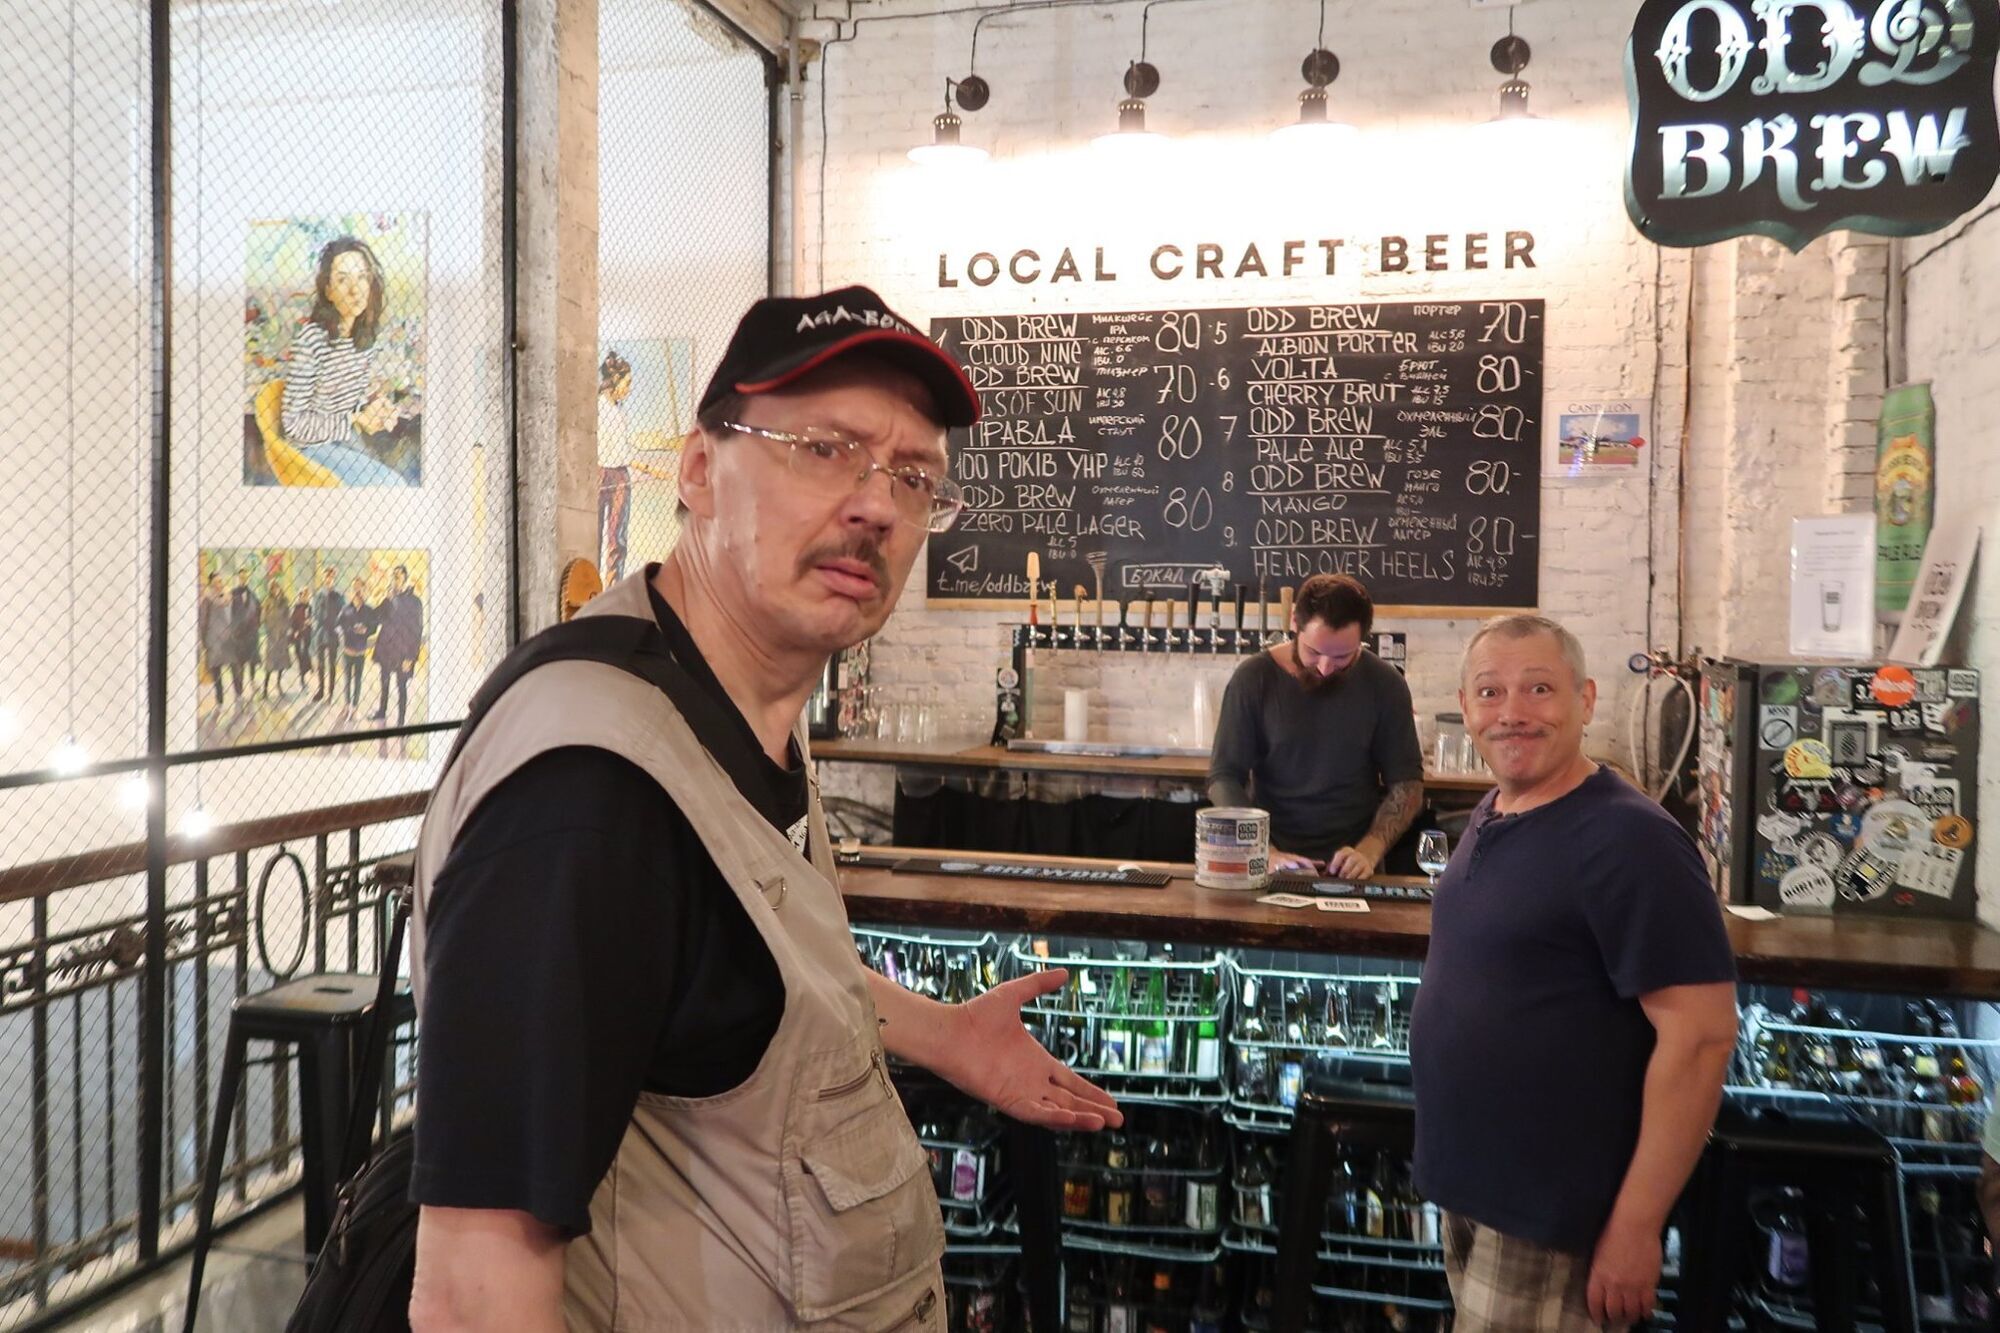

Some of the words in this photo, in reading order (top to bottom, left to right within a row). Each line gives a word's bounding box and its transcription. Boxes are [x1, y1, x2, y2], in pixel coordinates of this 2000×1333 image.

[1658, 106, 1972, 211] BREW
[938, 246, 1117, 288] LOCAL
[1150, 238, 1345, 281] CRAFT
[1380, 230, 1538, 273] BEER
[961, 316, 1008, 341] ODD
[1248, 307, 1296, 331] ODD
[969, 344, 1030, 367] CLOUD
[1258, 336, 1329, 357] ALBION
[1250, 357, 1338, 381] VOLTA
[1043, 389, 1082, 416] SUN
[1343, 381, 1405, 404] BRUT
[1250, 408, 1296, 435] ODD
[1222, 471, 1233, 492] 8
[1250, 464, 1304, 491] ODD
[961, 485, 1005, 509] ODD
[1262, 494, 1347, 515] MANGO
[1256, 519, 1304, 545] ODD
[1311, 518, 1378, 544] BREW
[1254, 551, 1312, 578] HEAD
[1318, 551, 1375, 580] OVER
[1382, 550, 1456, 581] HEELS
